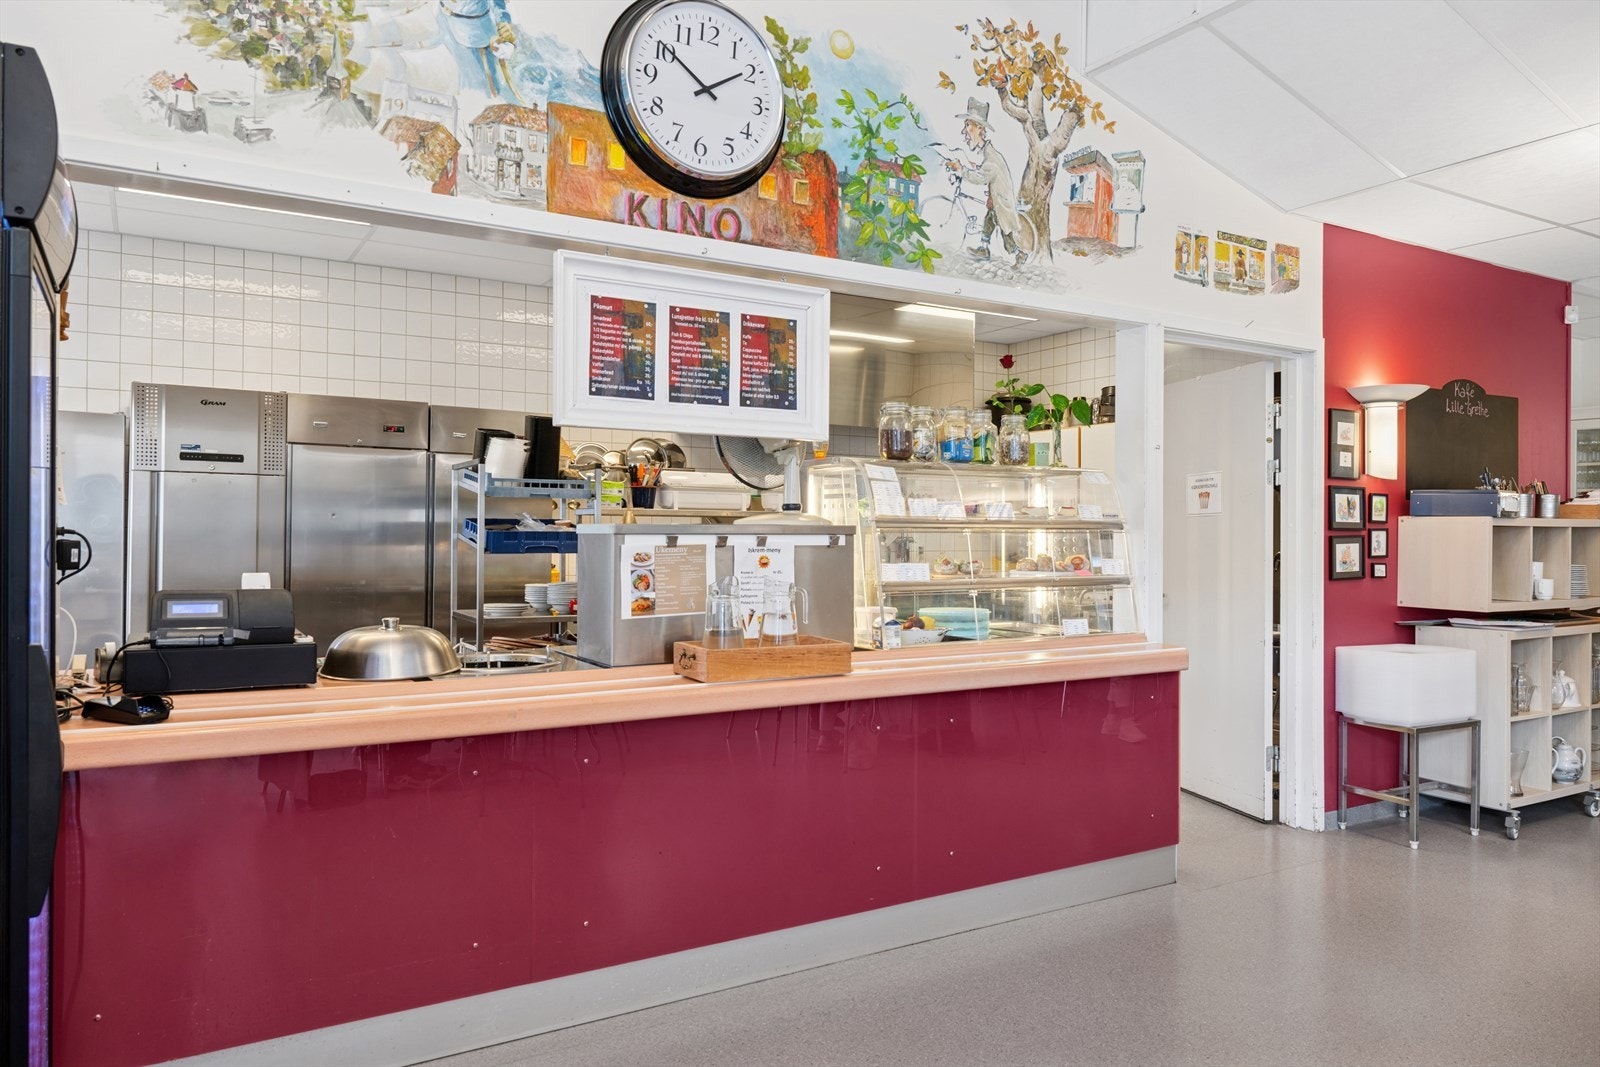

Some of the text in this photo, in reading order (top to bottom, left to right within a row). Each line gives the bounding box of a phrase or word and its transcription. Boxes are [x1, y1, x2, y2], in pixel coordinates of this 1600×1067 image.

[675, 24, 691, 46] 11
[697, 22, 720, 46] 12
[654, 40, 675, 63] 10
[730, 41, 738, 60] 1
[644, 64, 658, 84] 9
[744, 64, 756, 84] 2
[385, 97, 404, 110] 19
[650, 96, 664, 116] 8
[752, 97, 763, 115] 3
[672, 122, 684, 142] 7
[740, 122, 752, 140] 4
[694, 136, 707, 157] 6
[722, 137, 735, 156] 5
[624, 191, 741, 241] KINO
[1454, 382, 1474, 405] Kafé
[1446, 398, 1490, 417] Lille Grethe
[656, 546, 688, 555] Ukemeny
